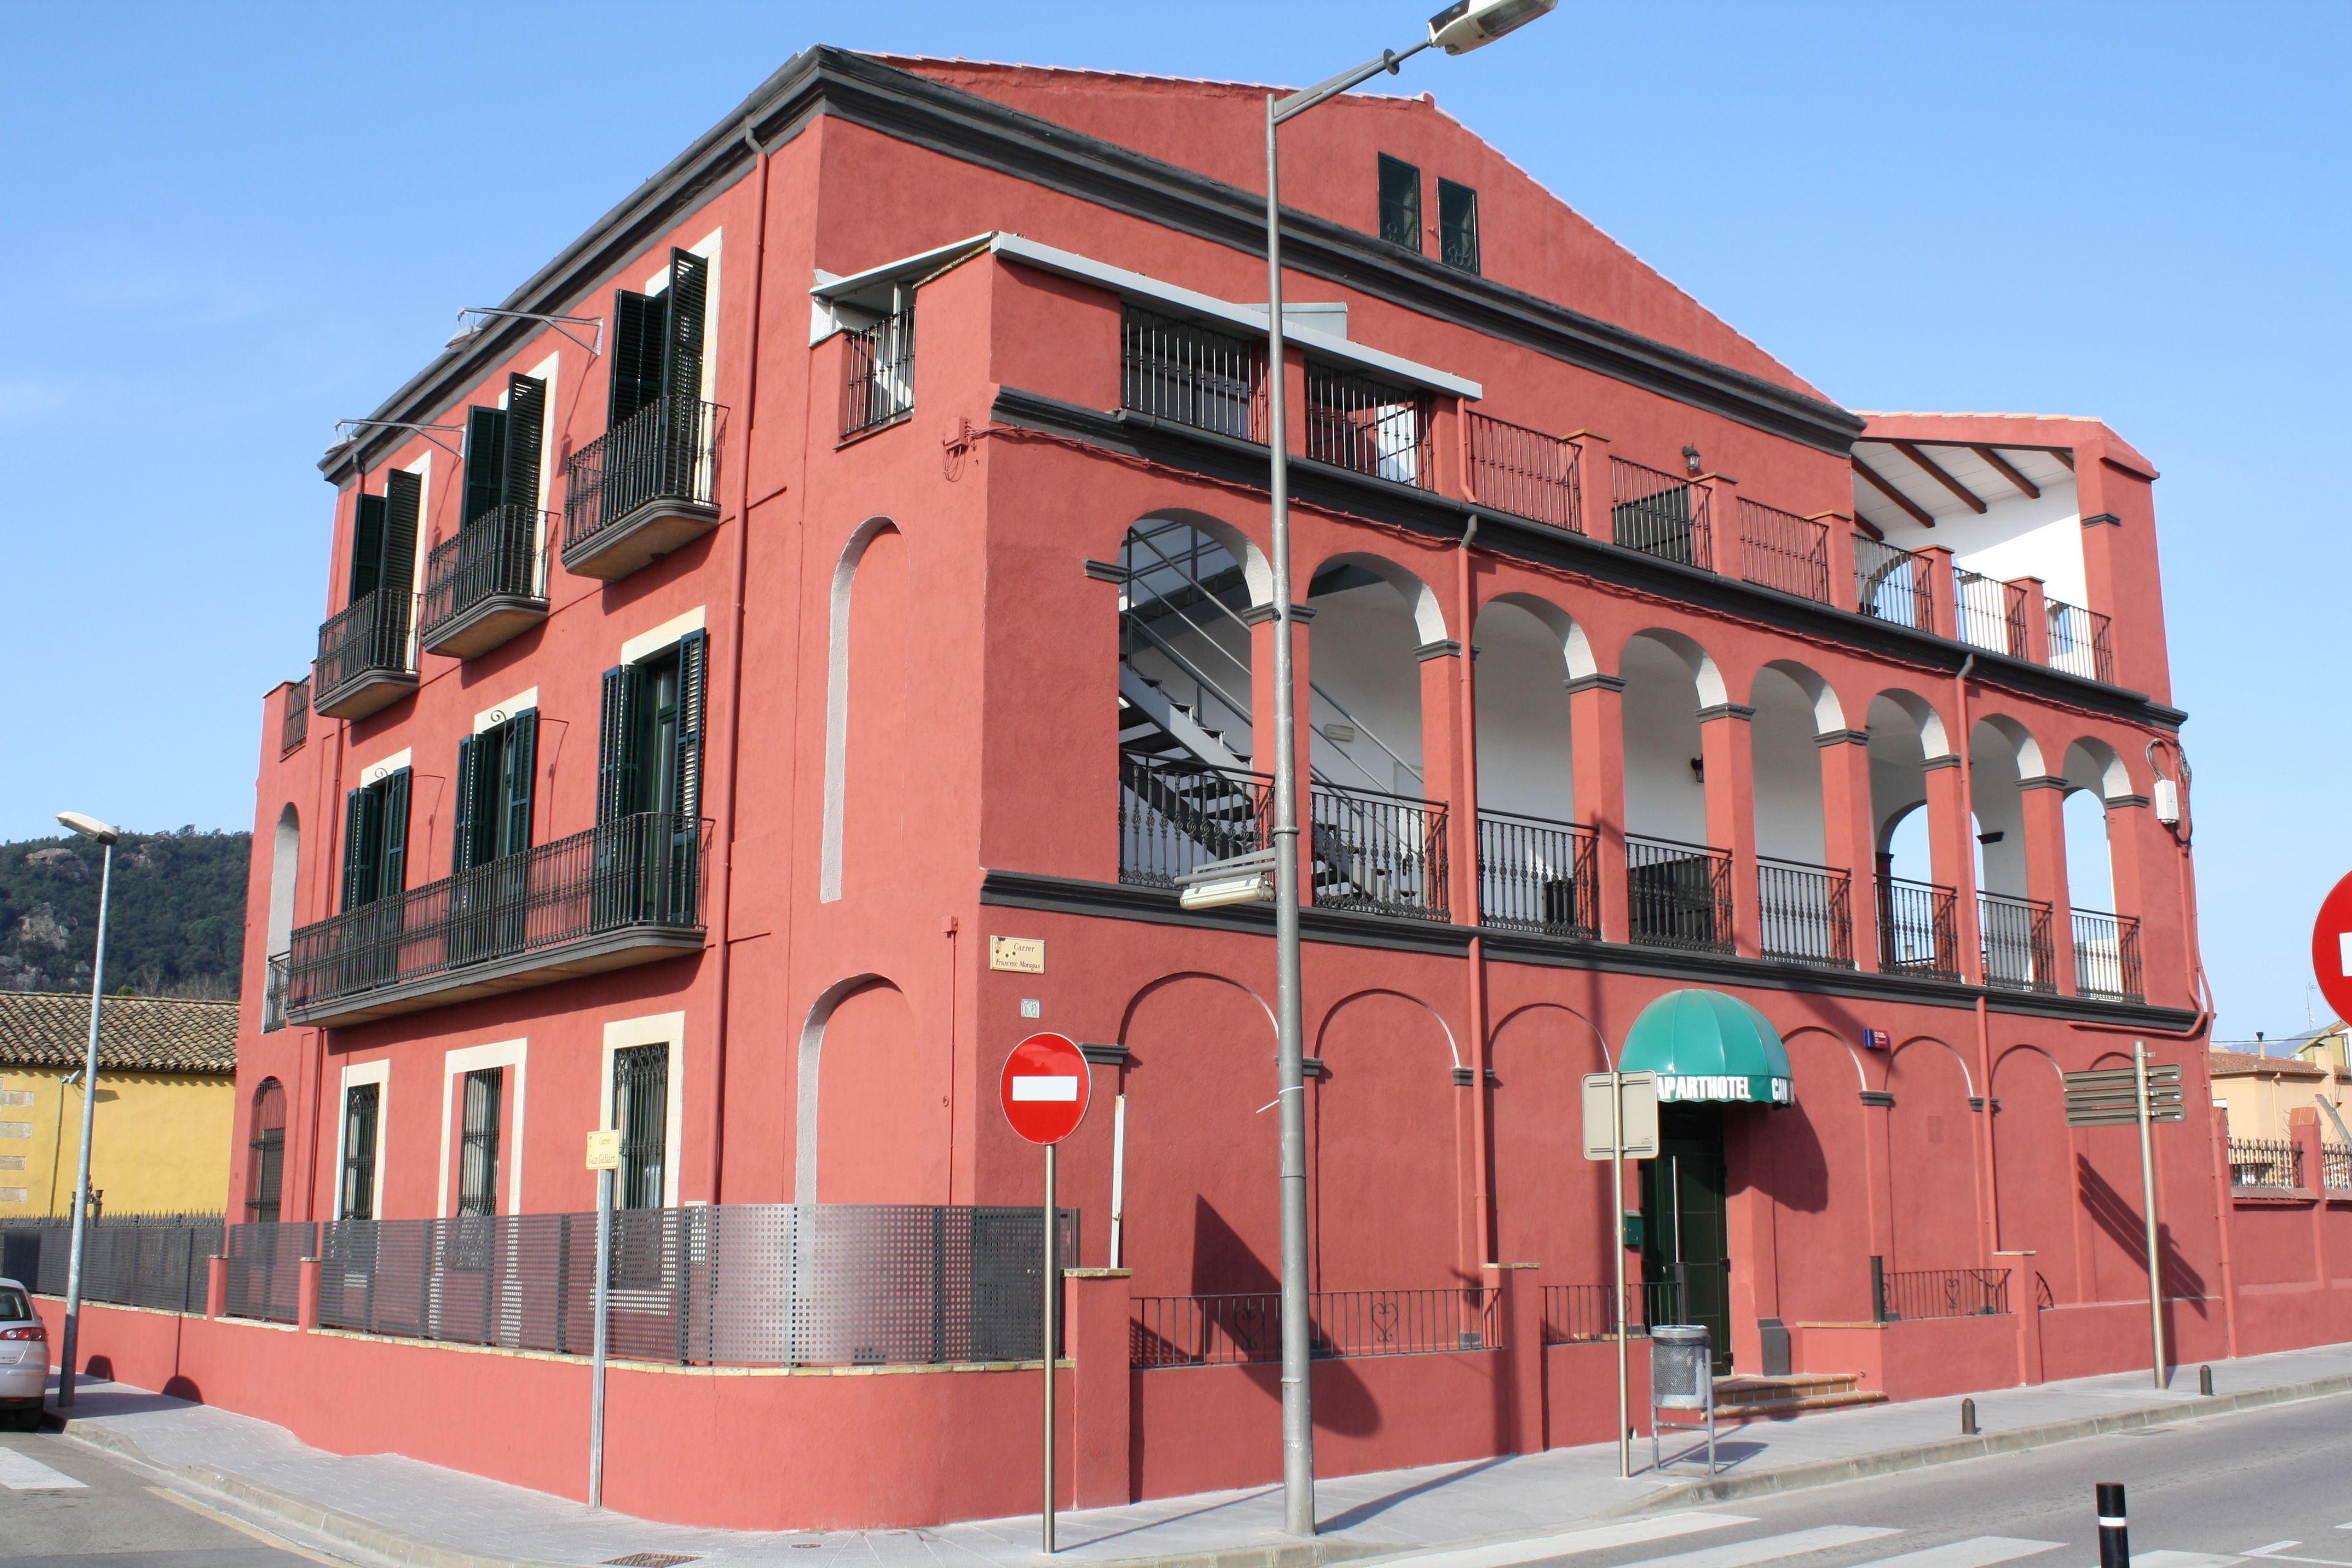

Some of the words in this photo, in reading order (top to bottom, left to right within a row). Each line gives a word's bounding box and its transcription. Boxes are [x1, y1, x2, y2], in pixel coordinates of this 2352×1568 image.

[1014, 943, 1035, 952] Carrer
[995, 958, 1018, 967] Francesc
[1657, 1076, 1752, 1100] APARTHOTEL
